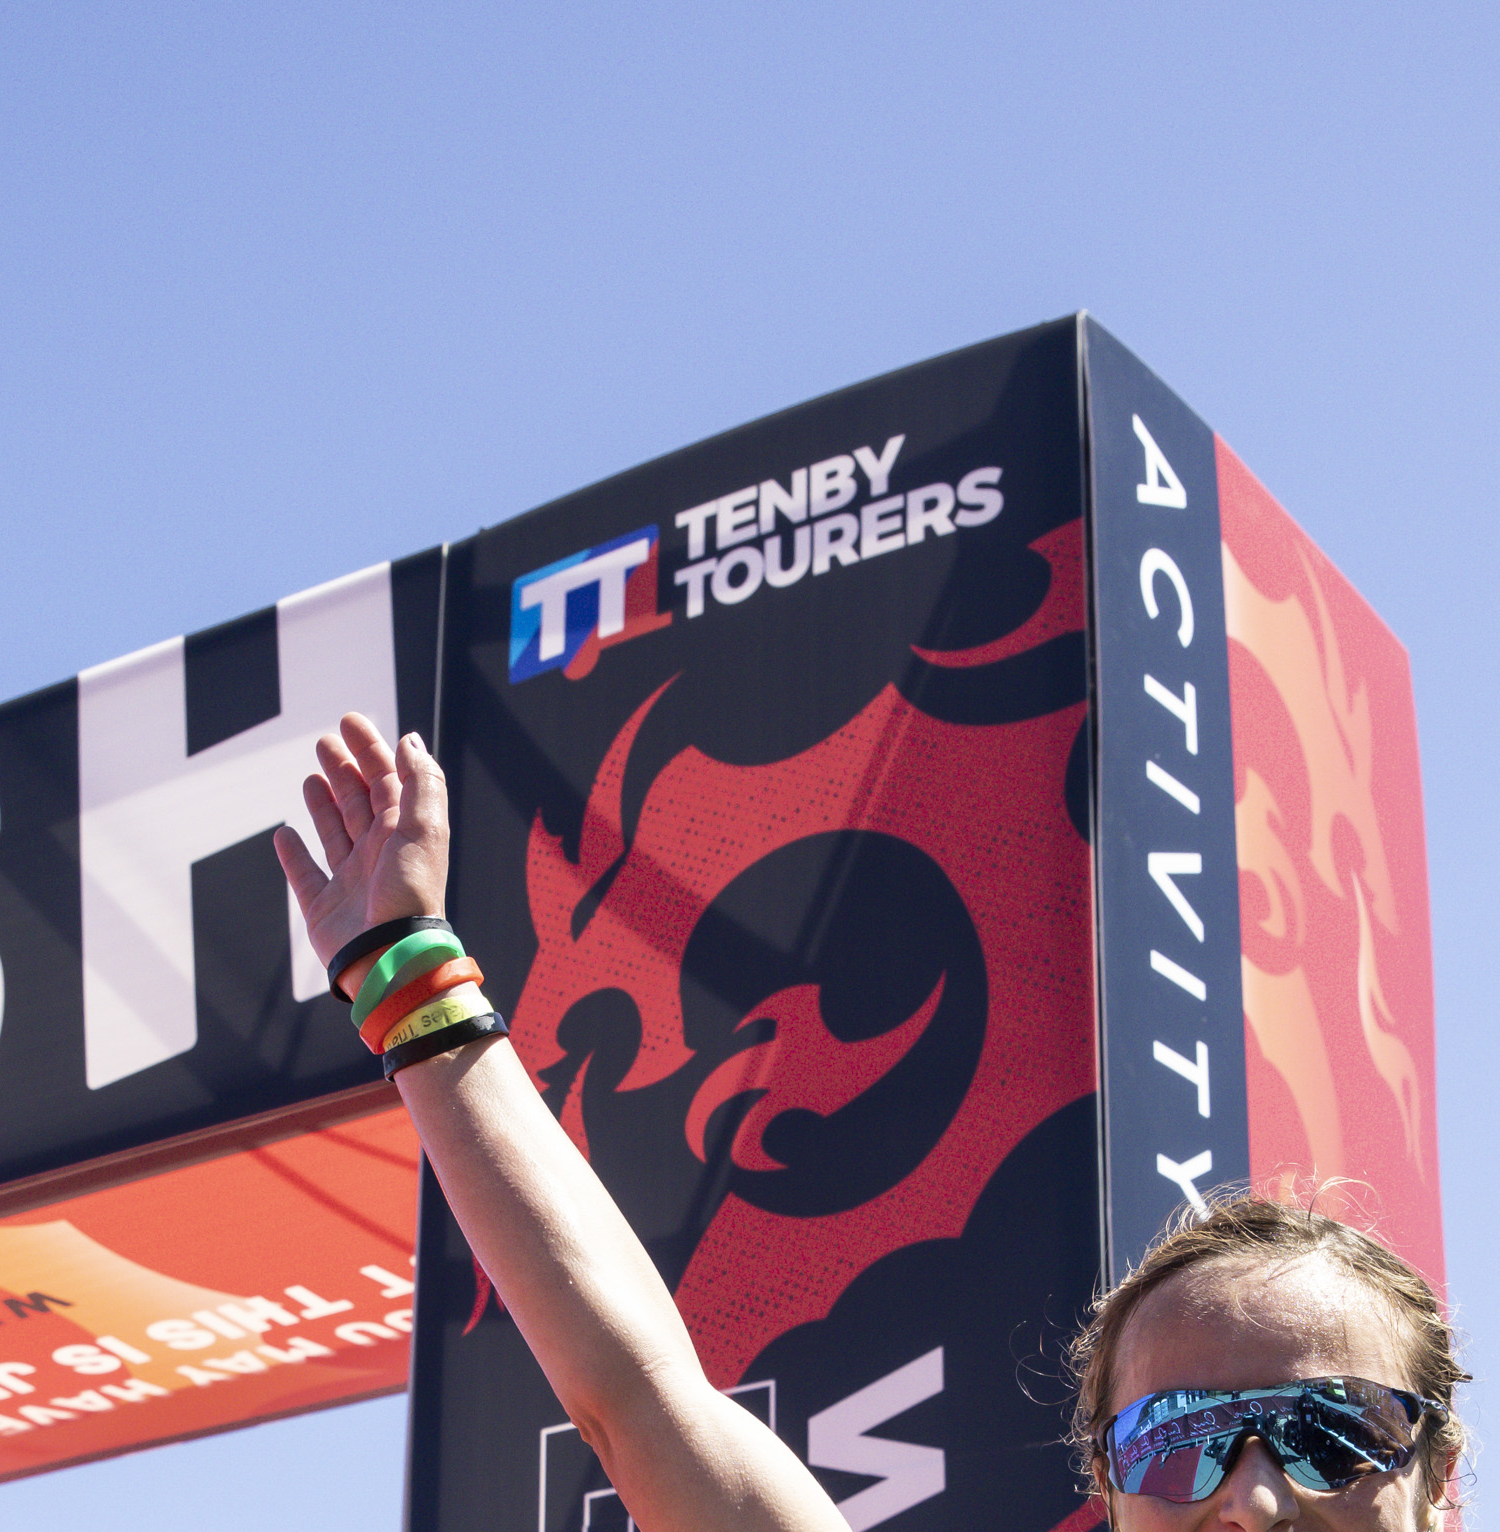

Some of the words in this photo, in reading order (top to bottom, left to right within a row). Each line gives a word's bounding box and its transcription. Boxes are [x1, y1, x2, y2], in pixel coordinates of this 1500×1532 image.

[675, 434, 906, 560] TENBY
[674, 467, 1005, 619] TOURERS
[146, 1284, 354, 1352] THIS
[52, 1335, 152, 1376] IS
[176, 1336, 336, 1387] MAY
